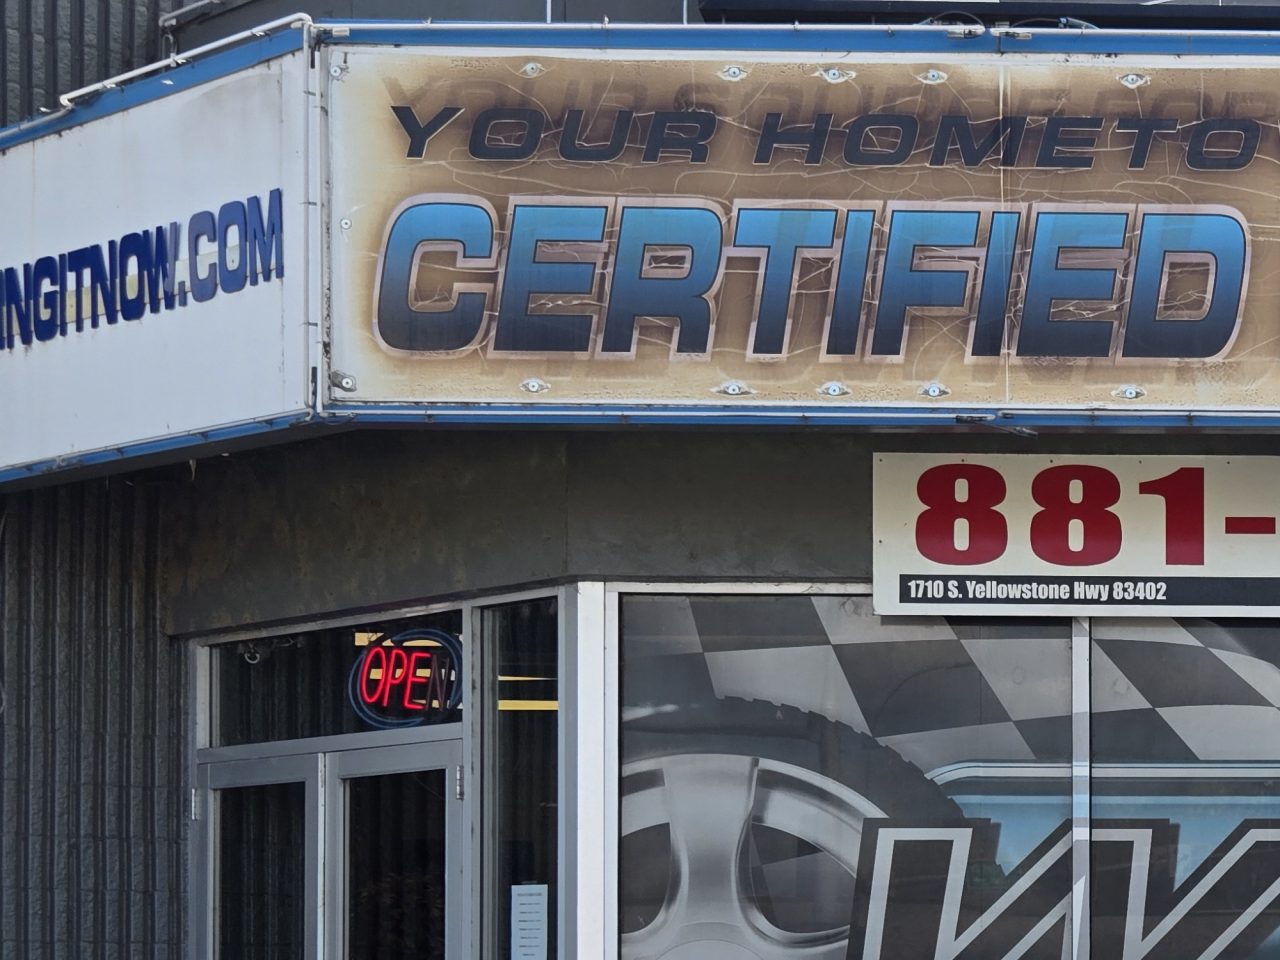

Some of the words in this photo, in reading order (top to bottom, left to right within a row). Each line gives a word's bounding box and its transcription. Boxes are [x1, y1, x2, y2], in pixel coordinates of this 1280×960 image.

[389, 104, 719, 164] YOUR
[374, 197, 1250, 363] CERTIFIED
[907, 579, 944, 599] 1710
[947, 579, 963, 599] S.
[966, 580, 1070, 600] Yellowstone
[1073, 581, 1110, 602] Hwy
[1112, 582, 1167, 601] 83402
[360, 646, 451, 712] OPEN
